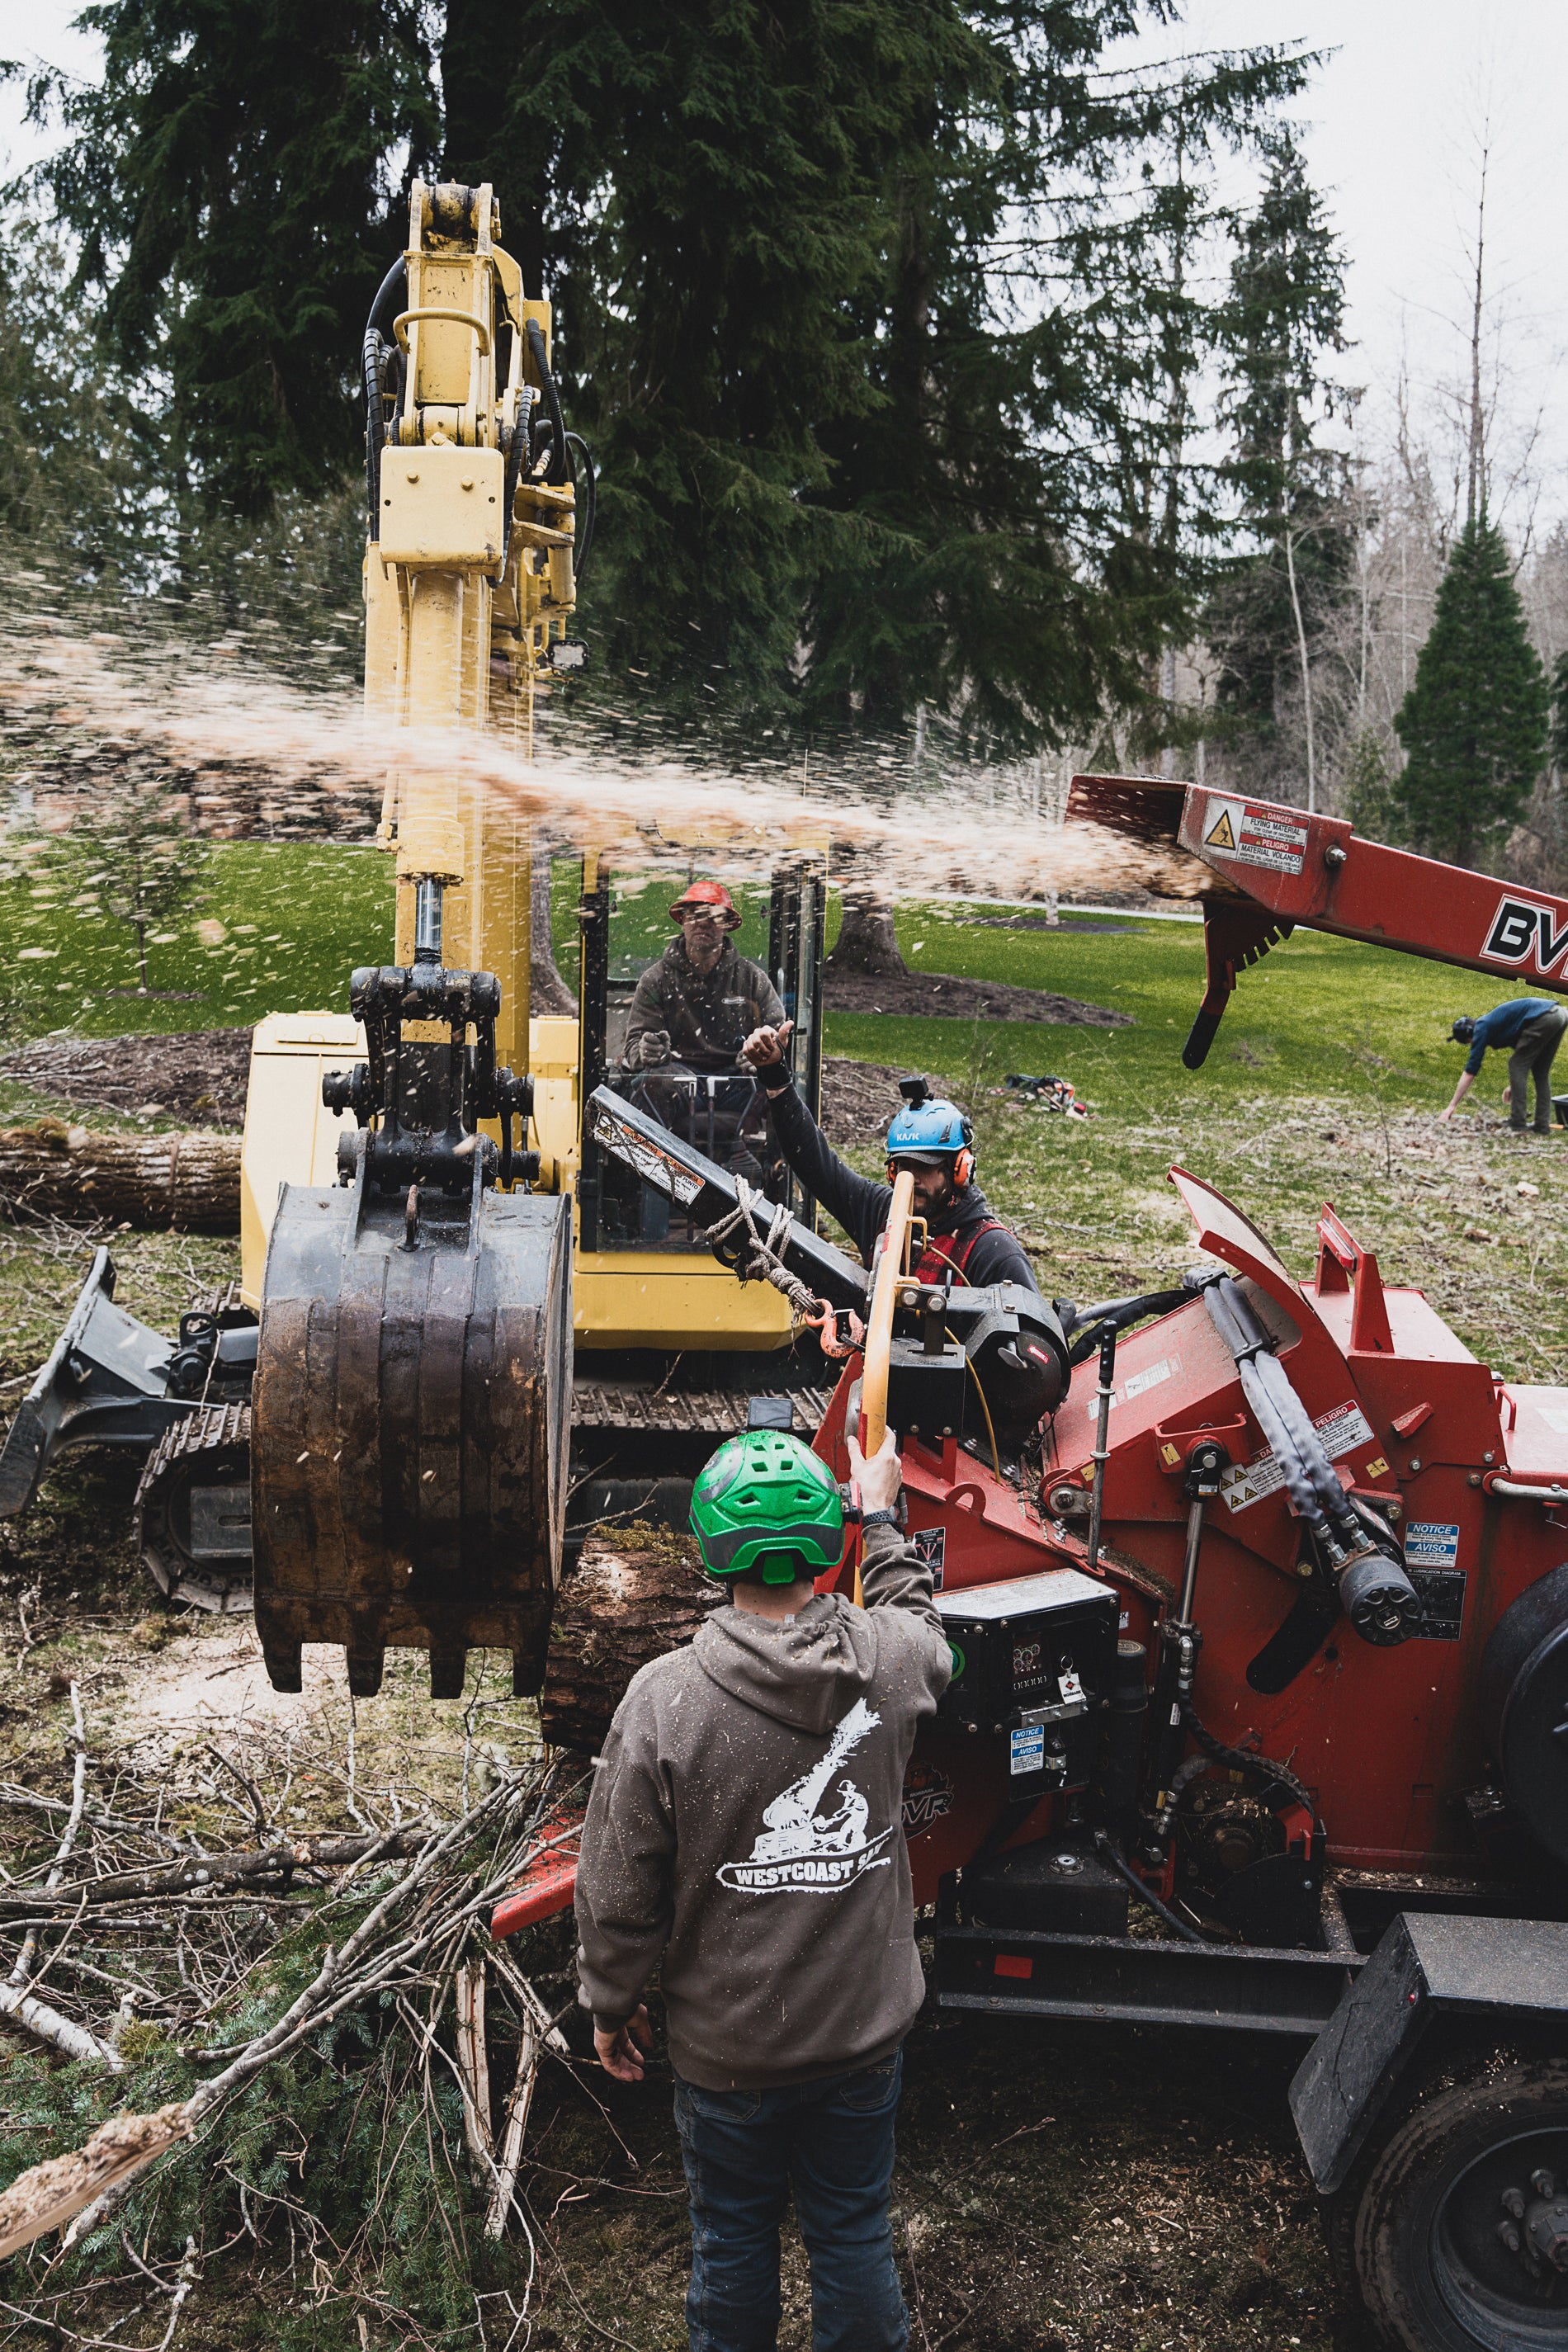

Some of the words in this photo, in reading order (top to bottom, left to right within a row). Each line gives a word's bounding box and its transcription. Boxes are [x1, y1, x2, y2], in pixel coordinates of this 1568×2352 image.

[1267, 812, 1293, 824] DANGER
[1250, 818, 1271, 829] FLYING
[1273, 823, 1301, 836] MATERIAL
[1261, 838, 1289, 851] PELIGRO
[1240, 844, 1269, 857] MATERIAL
[1272, 851, 1301, 863] VOLANDO
[1479, 893, 1568, 980] BV
[896, 1132, 920, 1141] KASK
[682, 1177, 699, 1190] PUNTO
[1315, 1406, 1348, 1428] PELIGRO
[1413, 1524, 1452, 1535] NOTICE
[1415, 1543, 1447, 1552] AVISO
[1016, 1727, 1040, 1739] NOTICE
[1018, 1745, 1037, 1755] AVISO
[902, 1792, 954, 1824] VR
[734, 1859, 854, 1887] WESTCOAST
